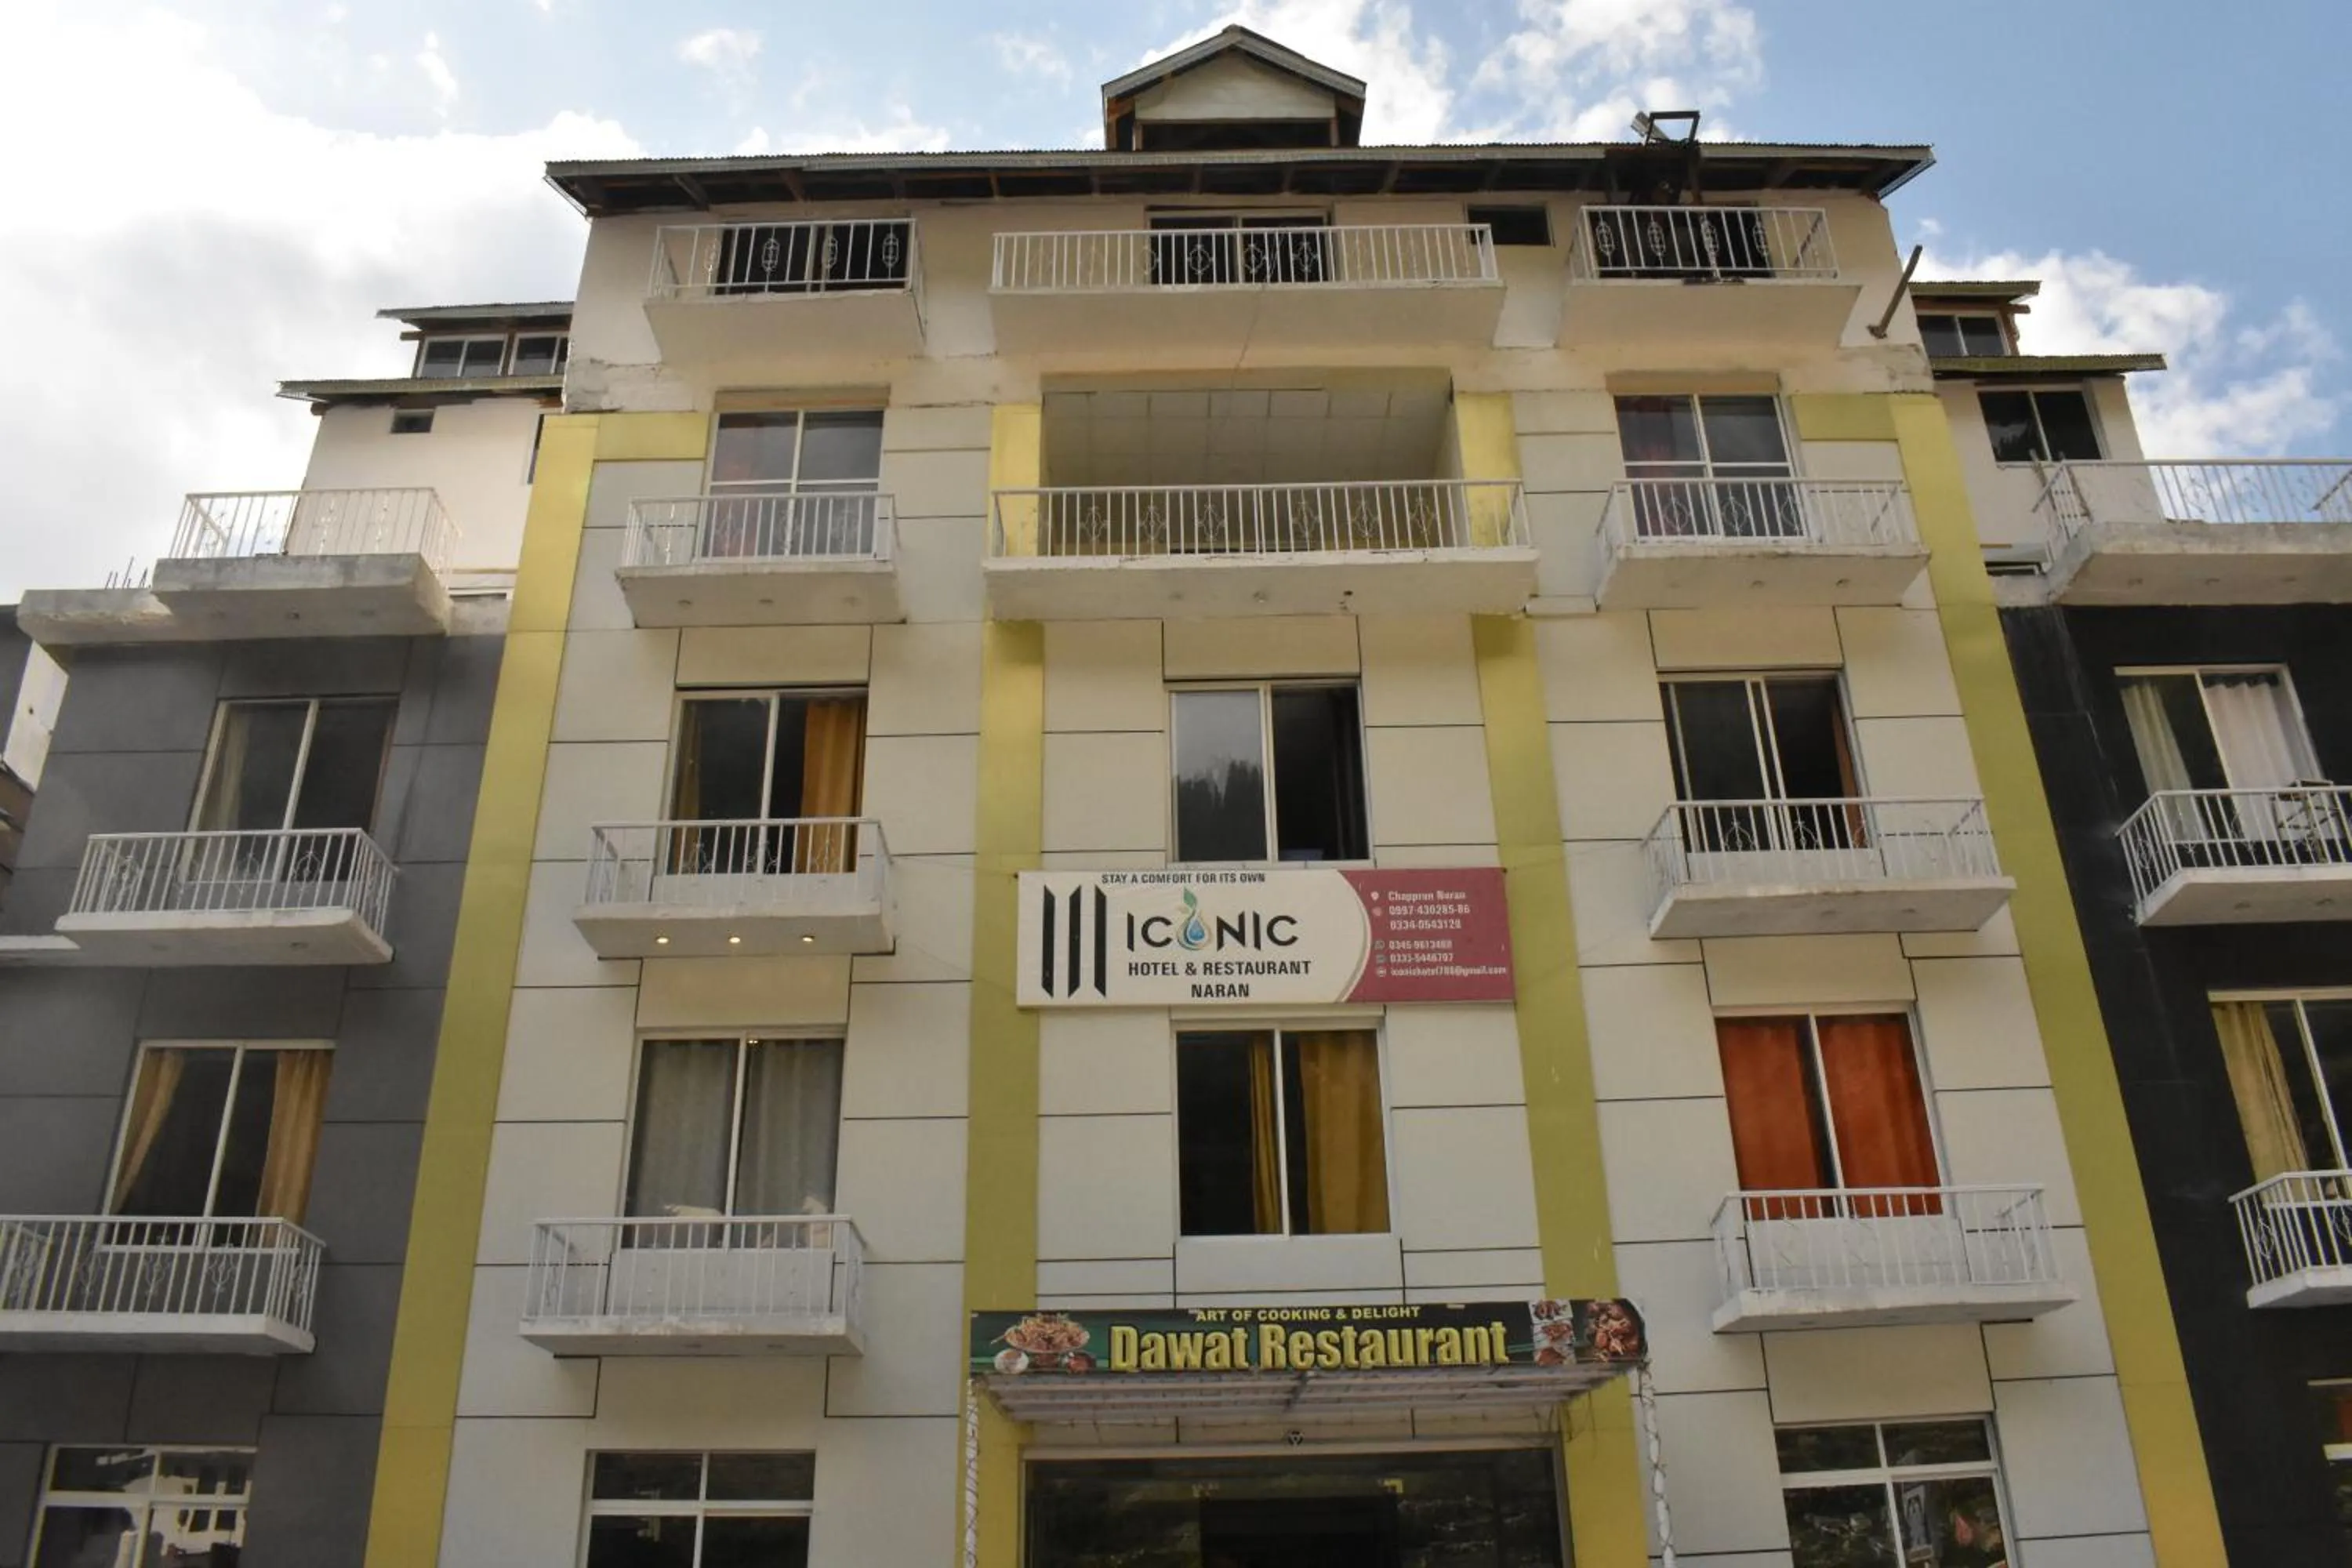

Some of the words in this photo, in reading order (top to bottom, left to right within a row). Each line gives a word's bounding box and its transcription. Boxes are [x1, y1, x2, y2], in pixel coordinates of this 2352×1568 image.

[1102, 874, 1127, 884] STAY
[1130, 874, 1138, 884] A
[1141, 873, 1192, 884] COMFORT
[1196, 873, 1217, 884] FOR
[1219, 873, 1236, 883] ITS
[1240, 873, 1266, 883] OWN
[1127, 902, 1299, 953] ICONIC
[1128, 962, 1179, 976] HOTEL
[1185, 962, 1197, 976] &
[1203, 960, 1312, 976] RESTAURANT
[1191, 984, 1250, 998] NARAN
[1196, 1310, 1227, 1322] ART
[1232, 1310, 1252, 1322] OF
[1257, 1308, 1330, 1321] COOKING
[1335, 1308, 1348, 1319] &
[1352, 1305, 1421, 1319] DELIGHT
[1110, 1325, 1250, 1371] Dawat
[1258, 1320, 1510, 1370] Restaurant
